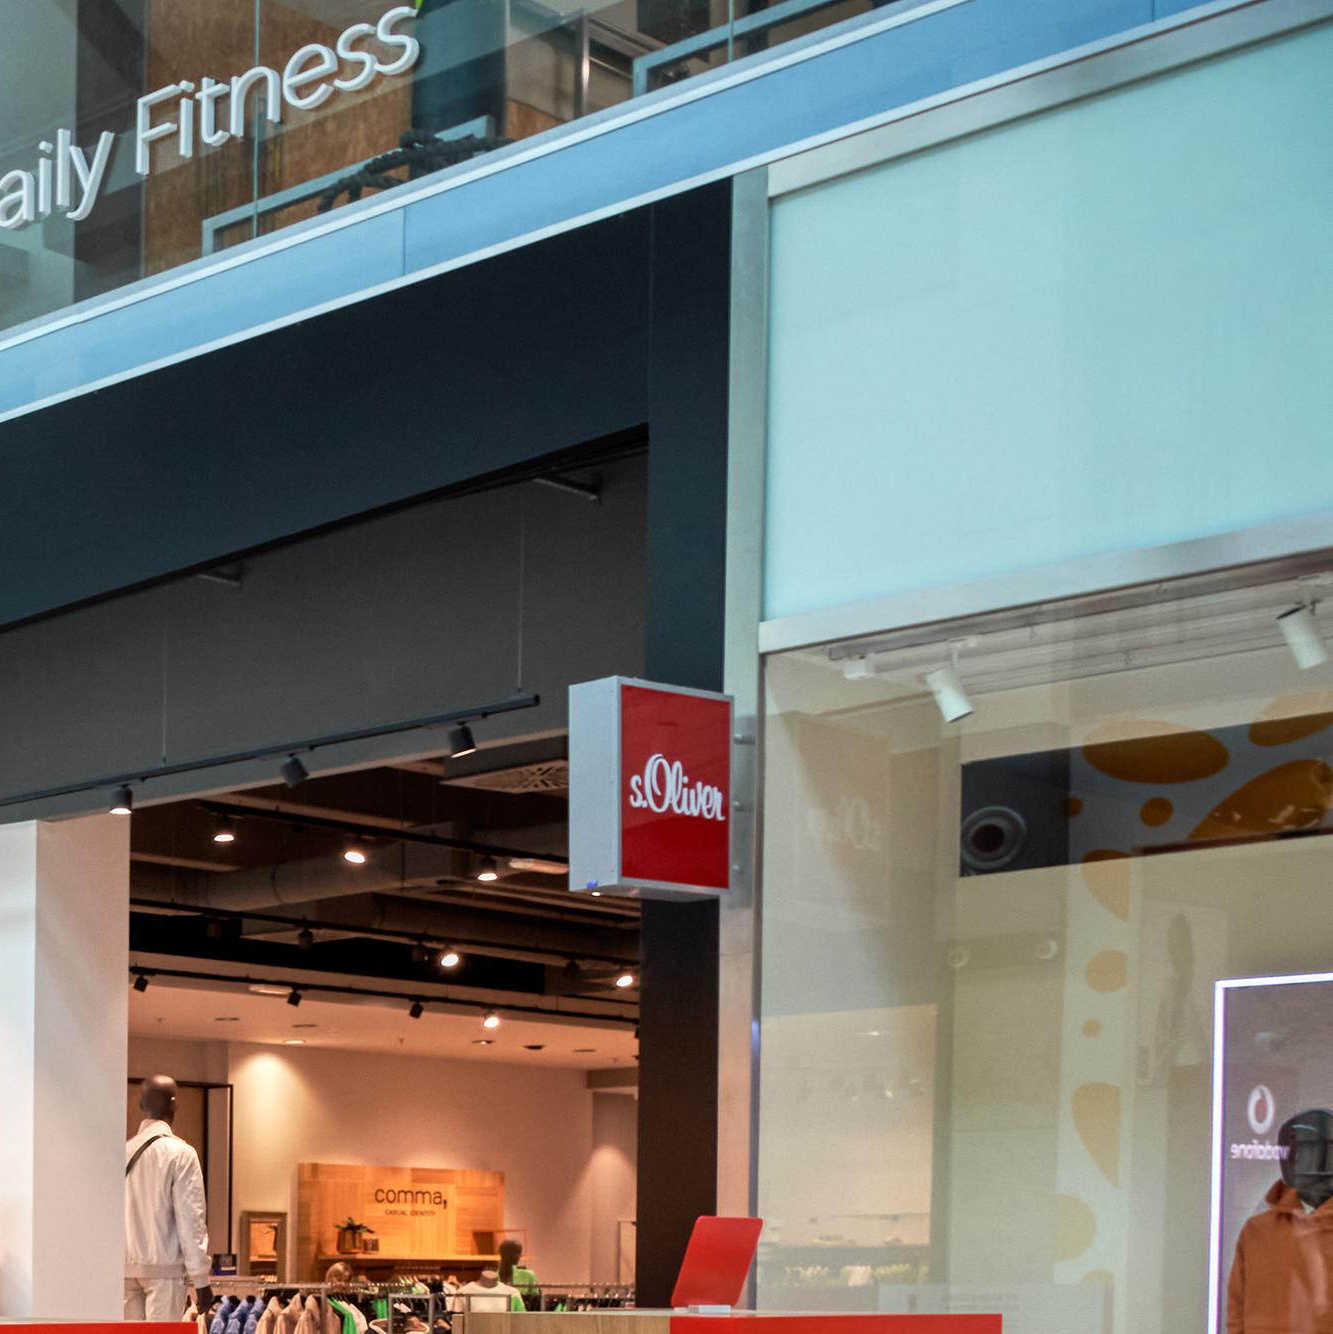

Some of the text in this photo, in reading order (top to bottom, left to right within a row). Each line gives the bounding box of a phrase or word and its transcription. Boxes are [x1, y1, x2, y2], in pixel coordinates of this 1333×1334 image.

[135, 5, 420, 176] Fitness
[630, 753, 725, 821] s.Oliver
[374, 1189, 448, 1210] comma,
